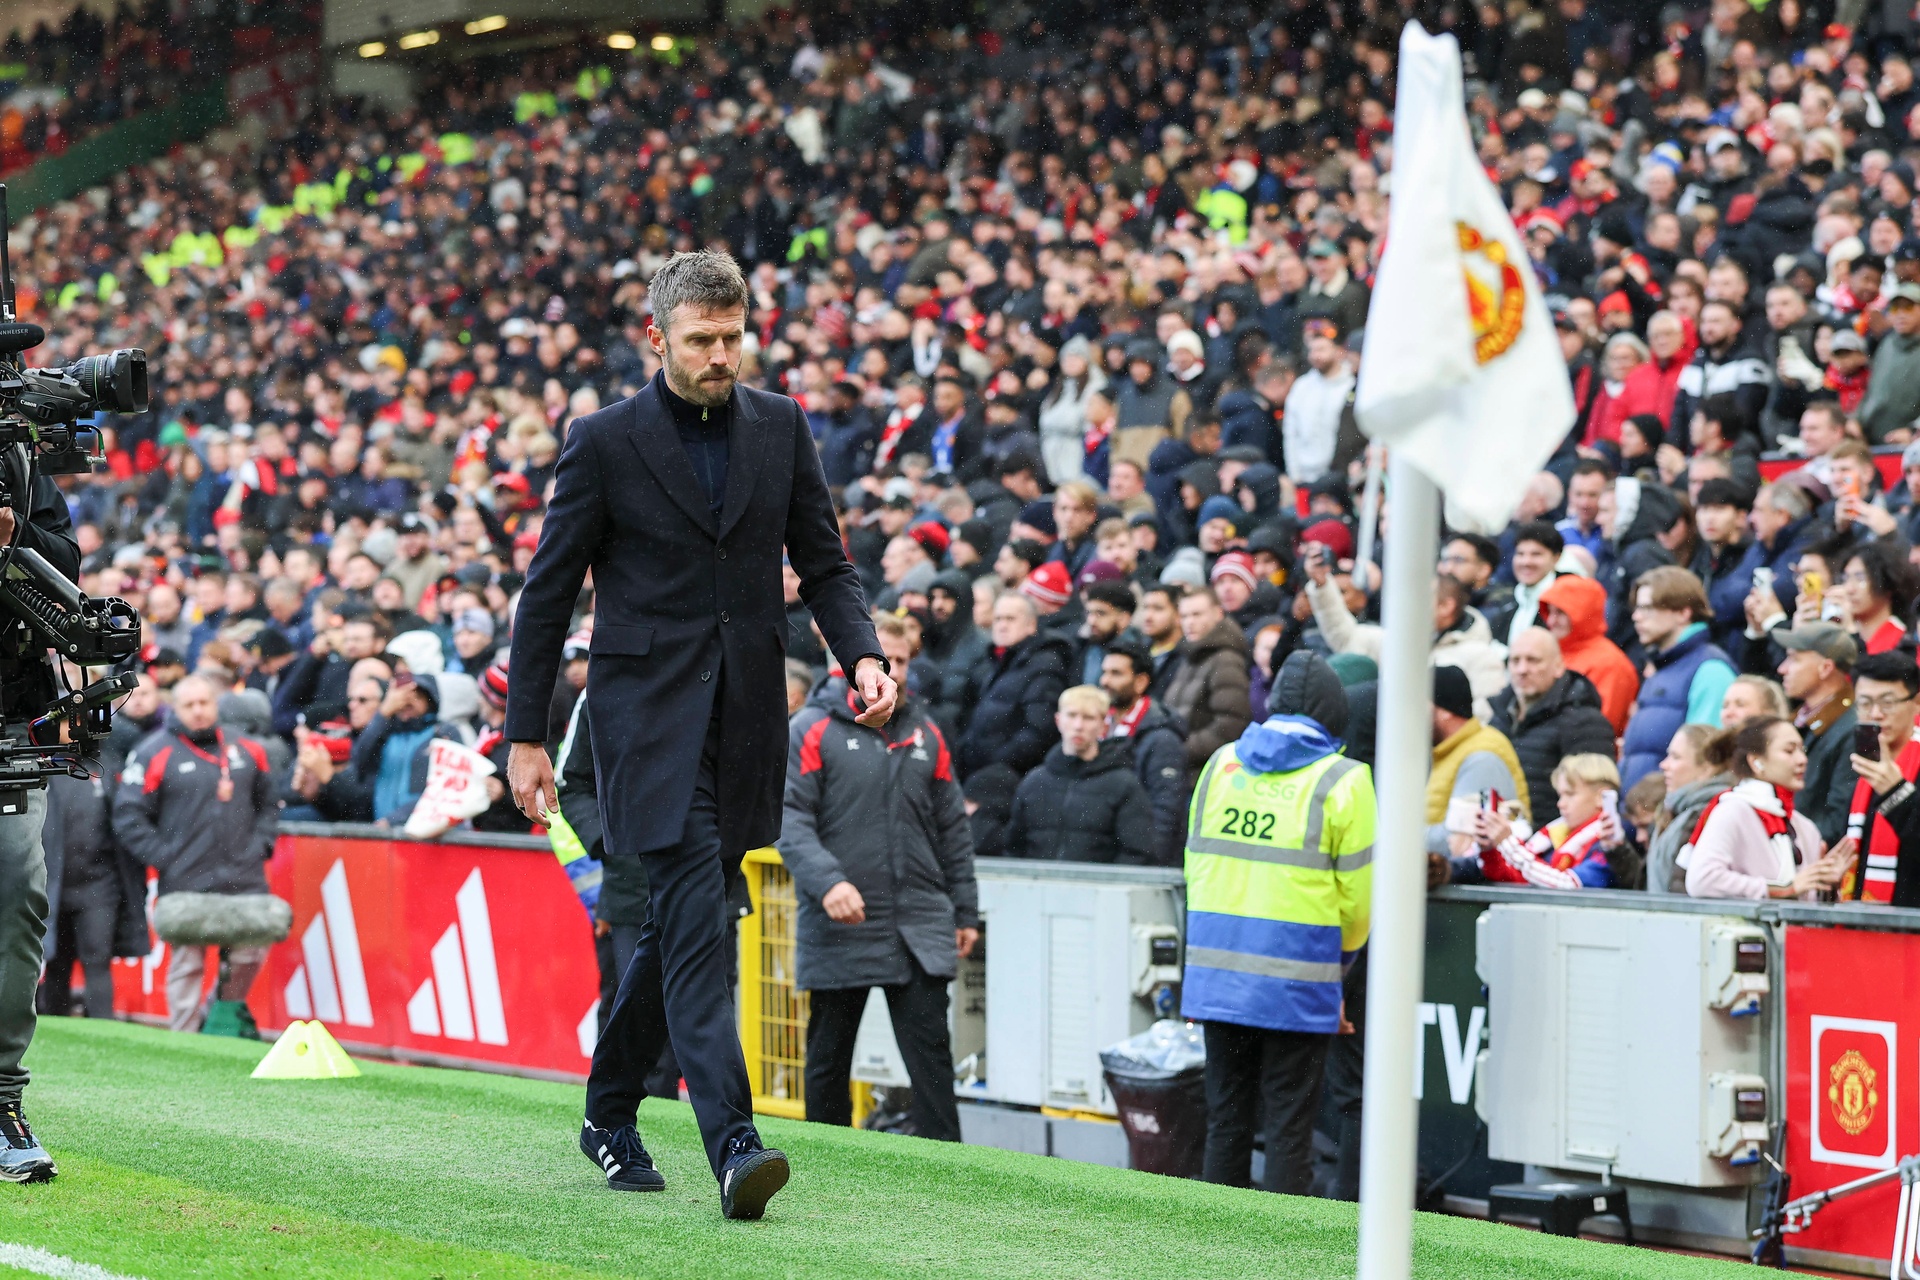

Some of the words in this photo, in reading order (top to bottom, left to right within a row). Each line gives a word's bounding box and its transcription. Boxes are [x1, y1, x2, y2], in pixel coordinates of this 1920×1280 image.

[20, 399, 37, 408] Canon
[1253, 778, 1297, 801] CSG
[1220, 807, 1276, 840] 282
[1838, 1112, 1868, 1128] UNITED
